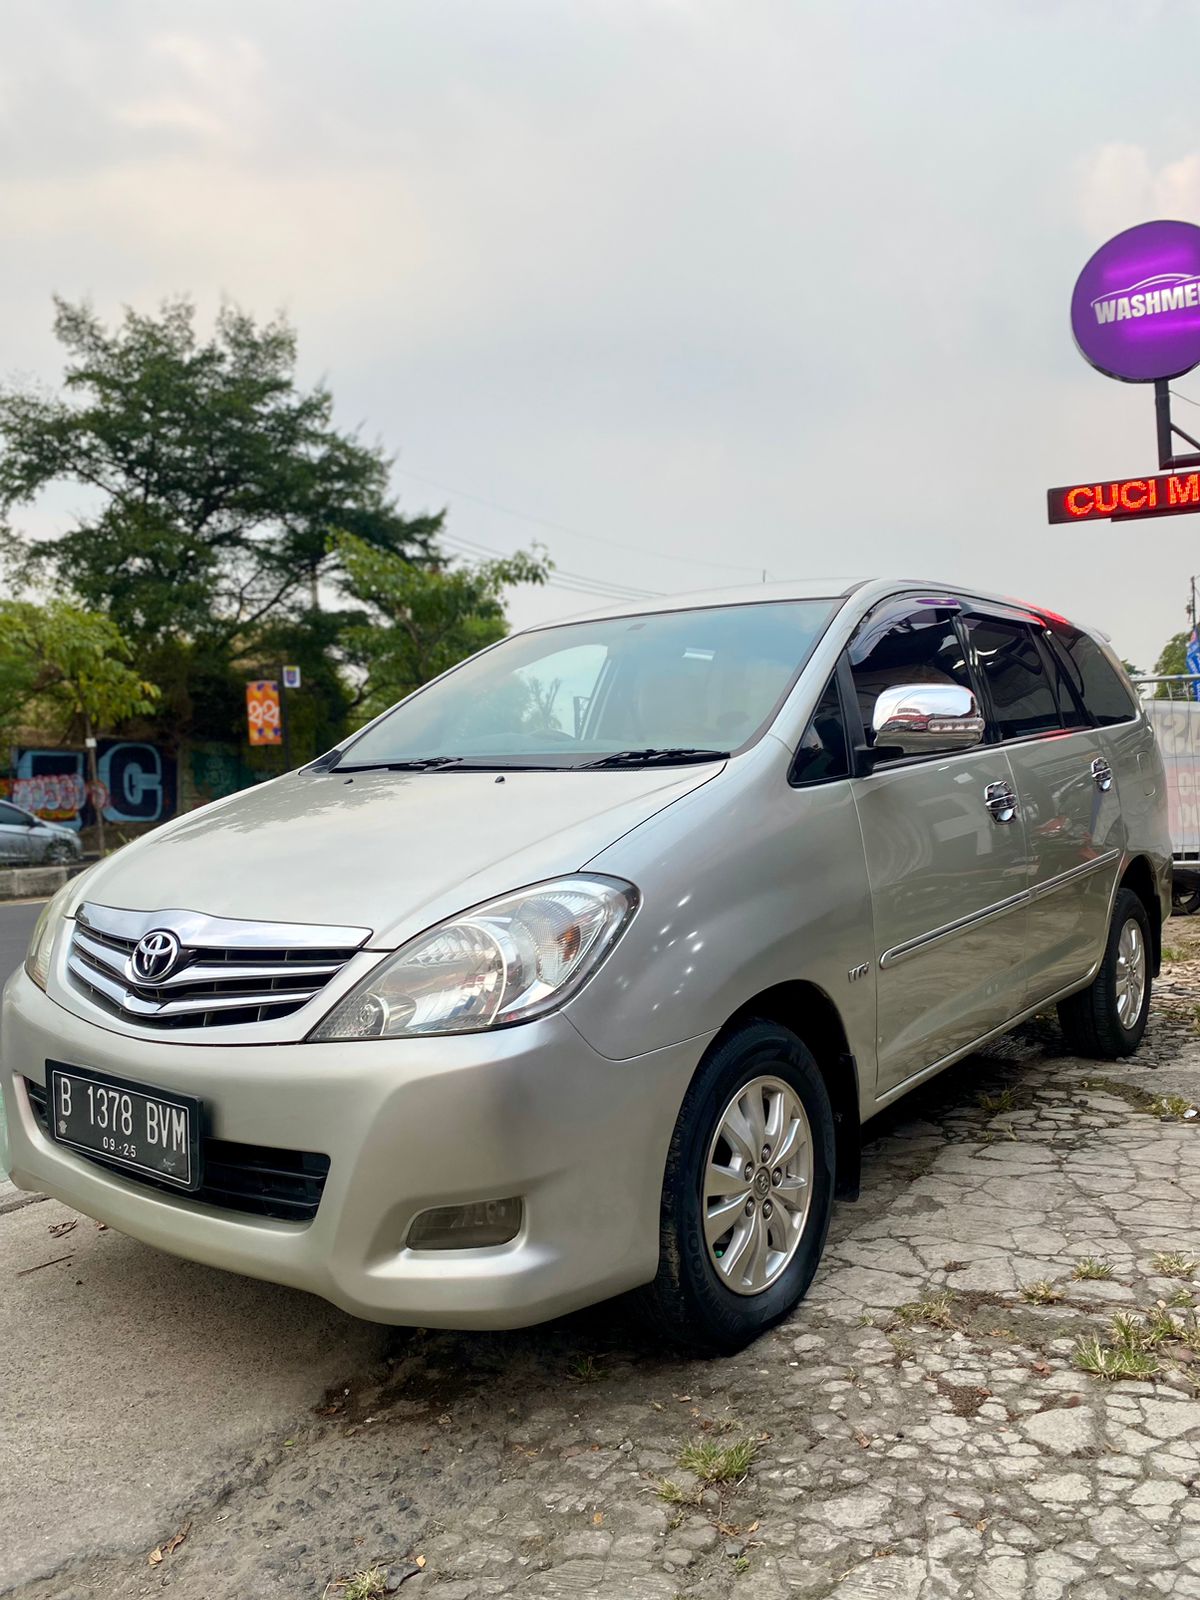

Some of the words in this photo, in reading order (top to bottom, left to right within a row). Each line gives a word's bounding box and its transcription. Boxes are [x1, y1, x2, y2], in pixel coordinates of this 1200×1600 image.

[1093, 282, 1200, 324] WASHME
[1067, 479, 1156, 515] CUCI
[1168, 474, 1200, 504] M
[61, 1077, 72, 1116] B
[88, 1086, 133, 1135] 1378
[146, 1101, 186, 1154] BVM
